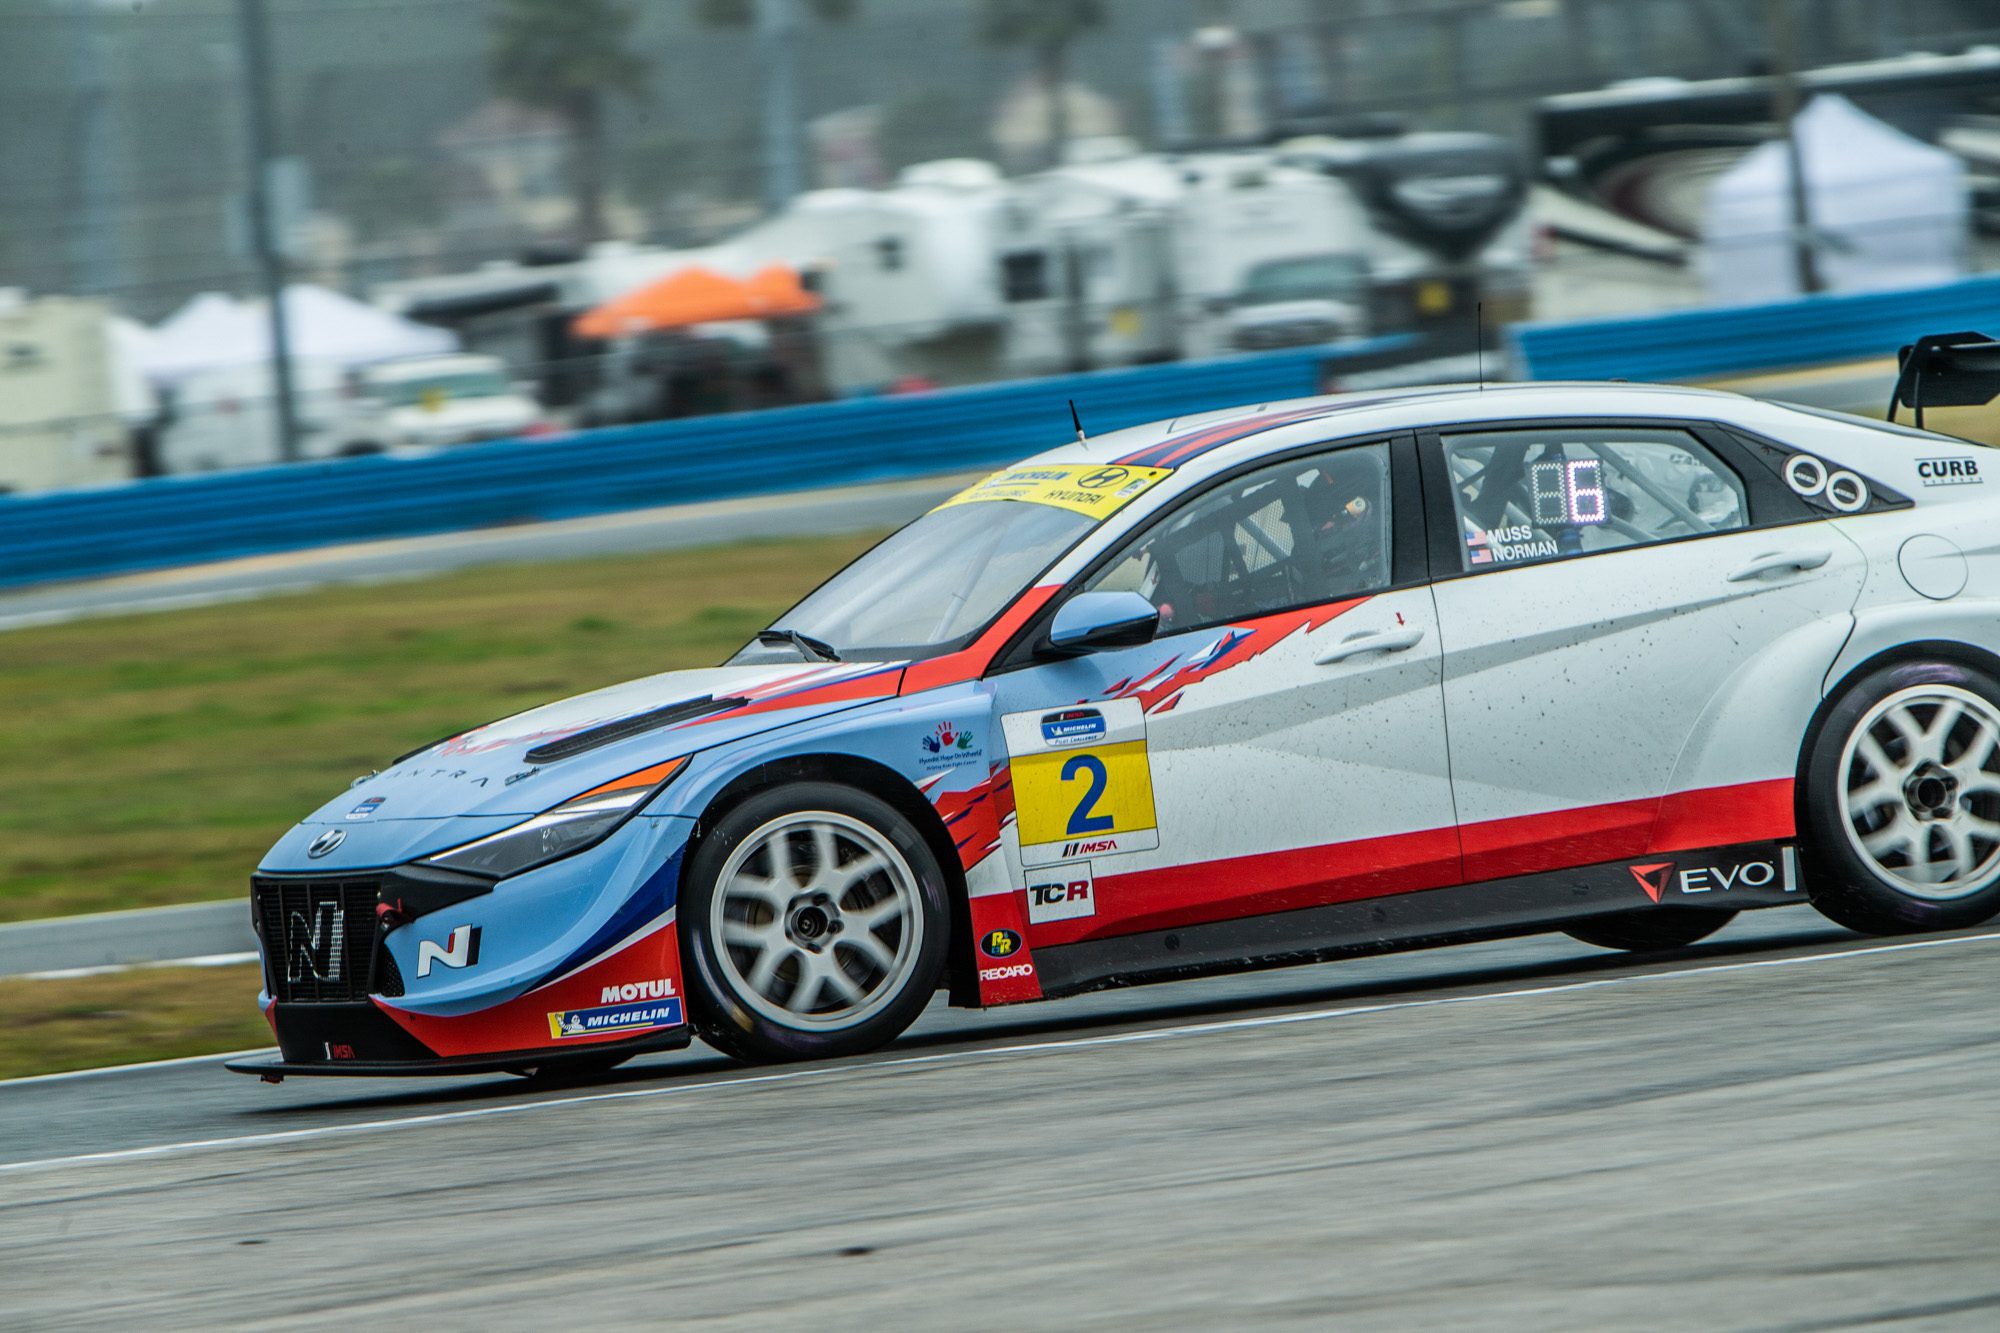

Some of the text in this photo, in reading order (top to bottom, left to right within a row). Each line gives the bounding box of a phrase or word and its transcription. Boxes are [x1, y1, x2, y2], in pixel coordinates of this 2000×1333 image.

[1918, 460, 1979, 478] CURB
[1043, 490, 1107, 505] HYUNDAI
[1486, 525, 1532, 544] MUSS
[1492, 540, 1559, 562] NORMAN
[1063, 722, 1097, 732] MICHELIN
[1060, 753, 1115, 836] 2
[1080, 840, 1118, 854] IMSA
[1679, 861, 1775, 893] EVO
[1029, 880, 1090, 906] TCR
[287, 901, 344, 982] N
[416, 923, 483, 979] N
[980, 963, 1033, 981] RECARO
[600, 978, 676, 1004] MOTUL
[587, 1007, 670, 1027] MICHELIN
